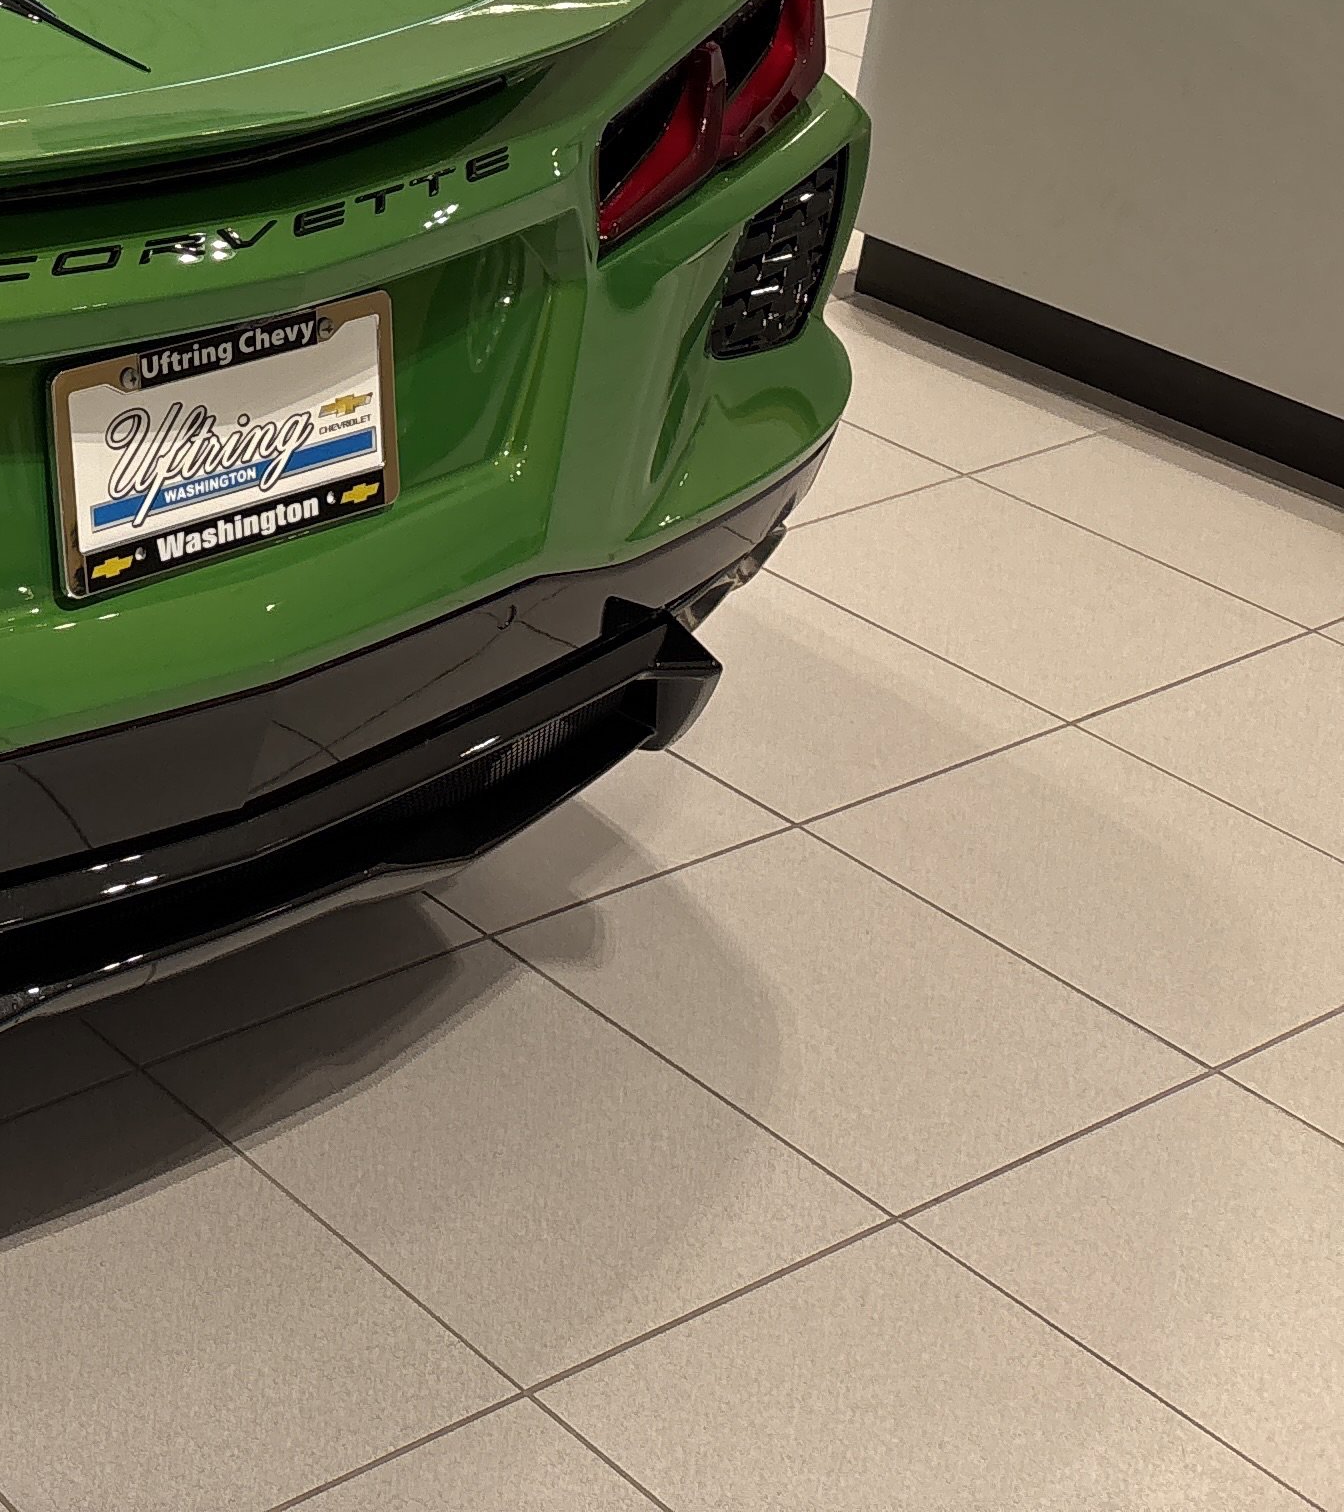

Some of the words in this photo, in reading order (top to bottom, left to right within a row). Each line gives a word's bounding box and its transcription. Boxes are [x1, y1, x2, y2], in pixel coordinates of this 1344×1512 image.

[140, 339, 234, 379] Uftring
[238, 319, 315, 355] Chevy
[318, 413, 373, 435] CHEVROLET
[105, 401, 314, 527] Uftring
[163, 465, 257, 504] WASHINGTON
[156, 495, 320, 562] Washington
